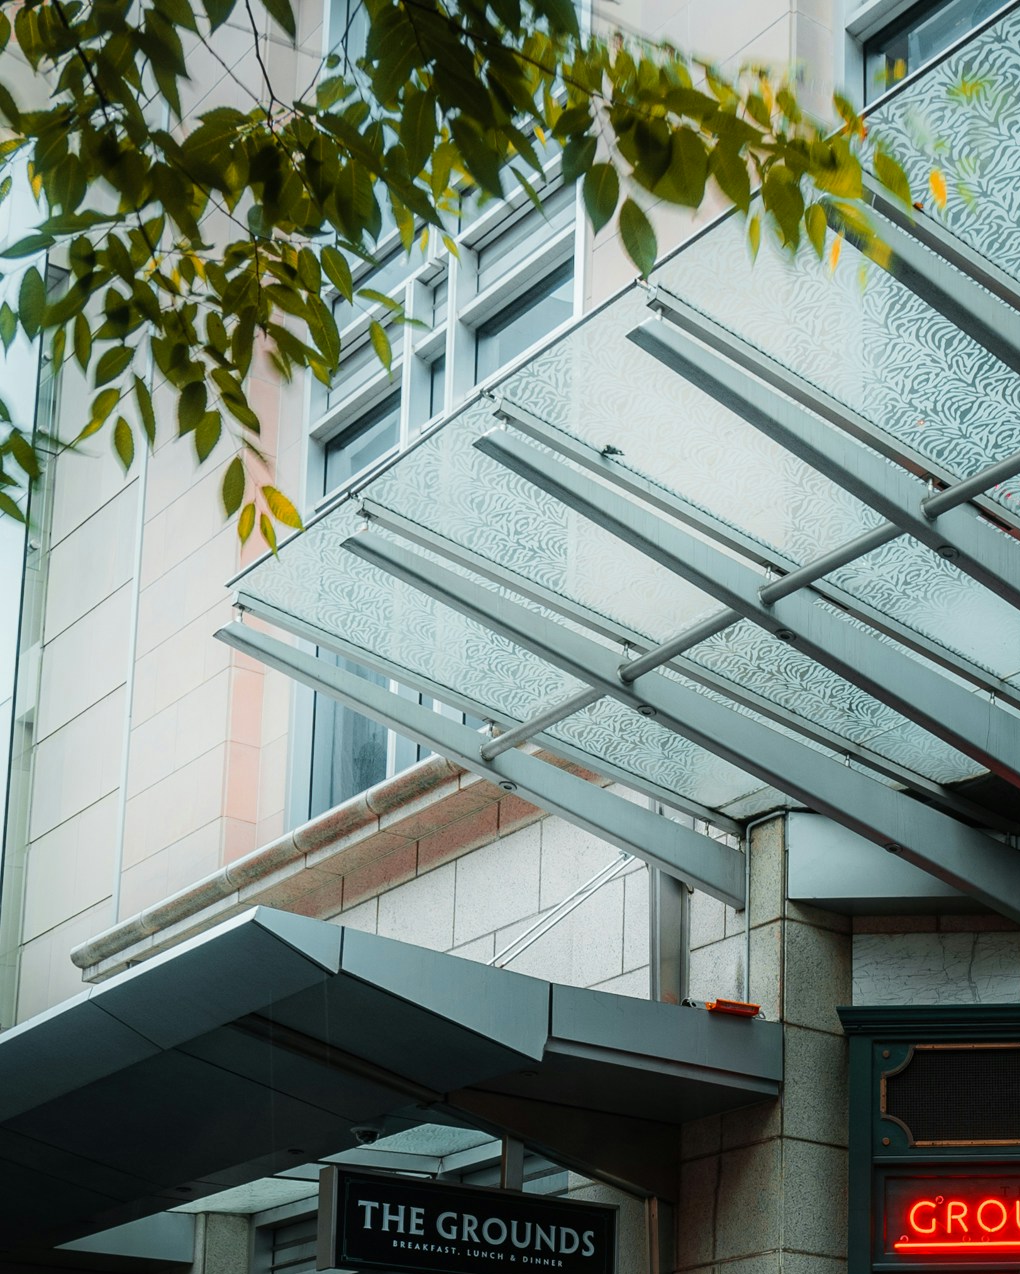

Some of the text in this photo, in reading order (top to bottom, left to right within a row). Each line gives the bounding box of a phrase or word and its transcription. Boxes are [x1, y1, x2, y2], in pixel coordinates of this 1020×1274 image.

[357, 1199, 595, 1257] THE GROUNDS
[467, 1249, 504, 1260] LUNCH
[510, 1254, 516, 1262] &
[522, 1256, 563, 1268] DINNER
